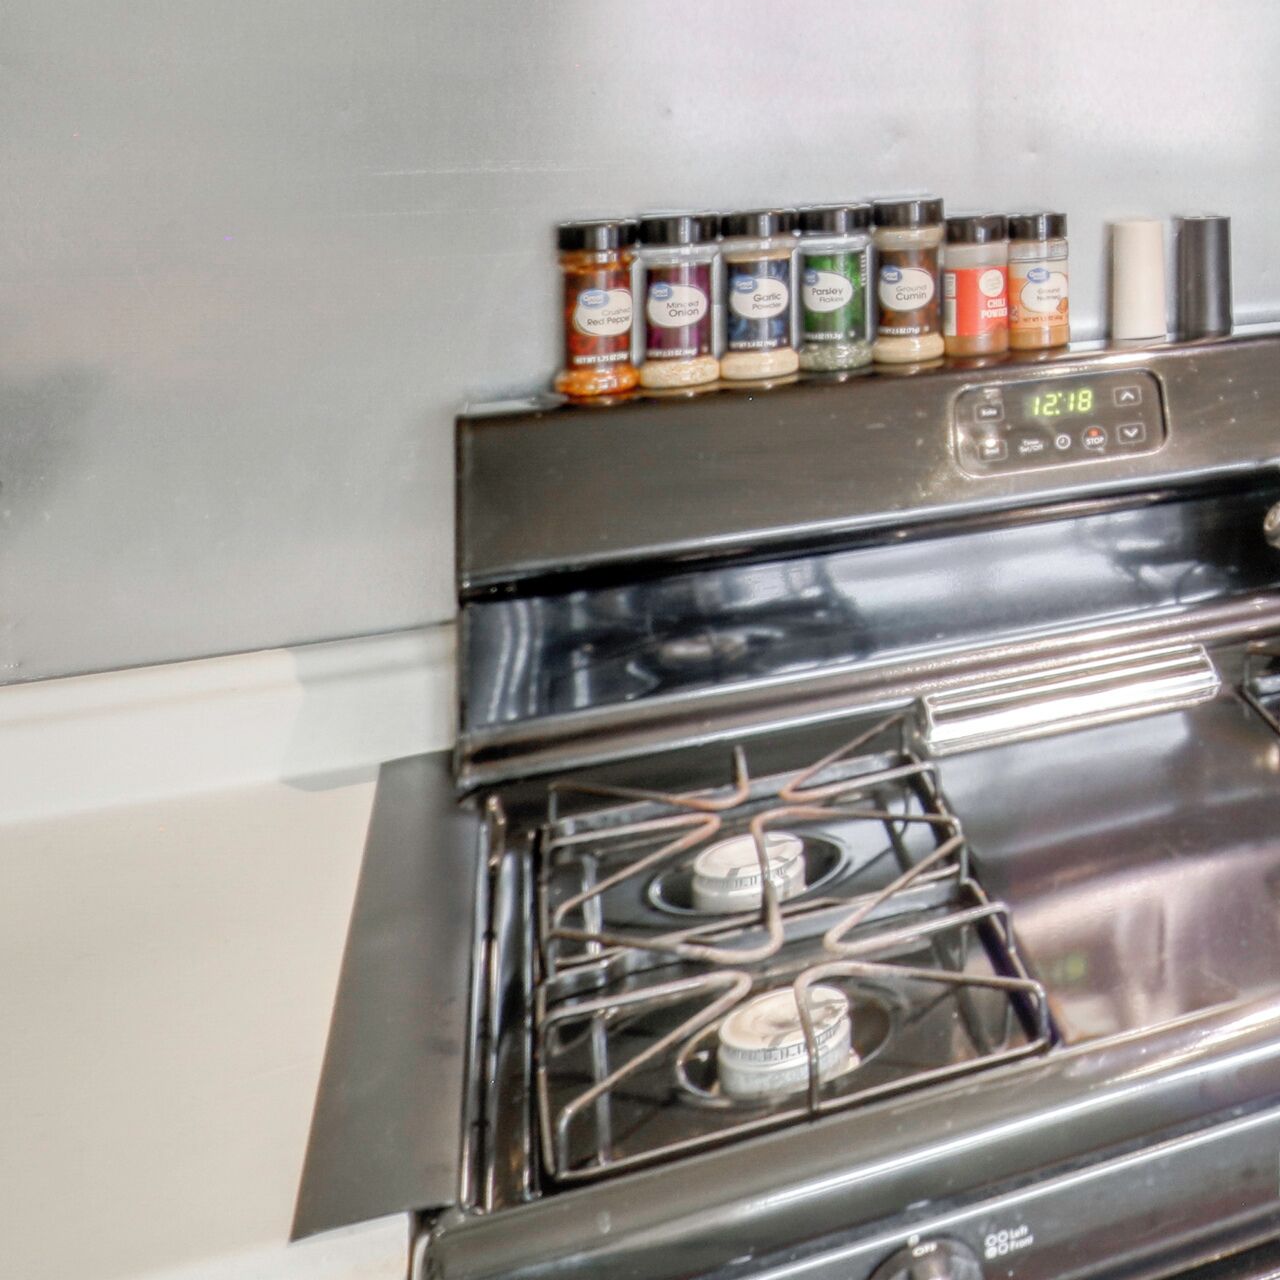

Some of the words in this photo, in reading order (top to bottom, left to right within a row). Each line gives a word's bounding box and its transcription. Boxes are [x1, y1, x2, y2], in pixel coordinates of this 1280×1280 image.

[811, 286, 844, 296] Parsley
[753, 292, 782, 302] Garlic
[895, 292, 927, 301] Cumin
[668, 308, 700, 318] Onion
[1031, 389, 1094, 416] 12:18
[1085, 436, 1105, 446] STOP
